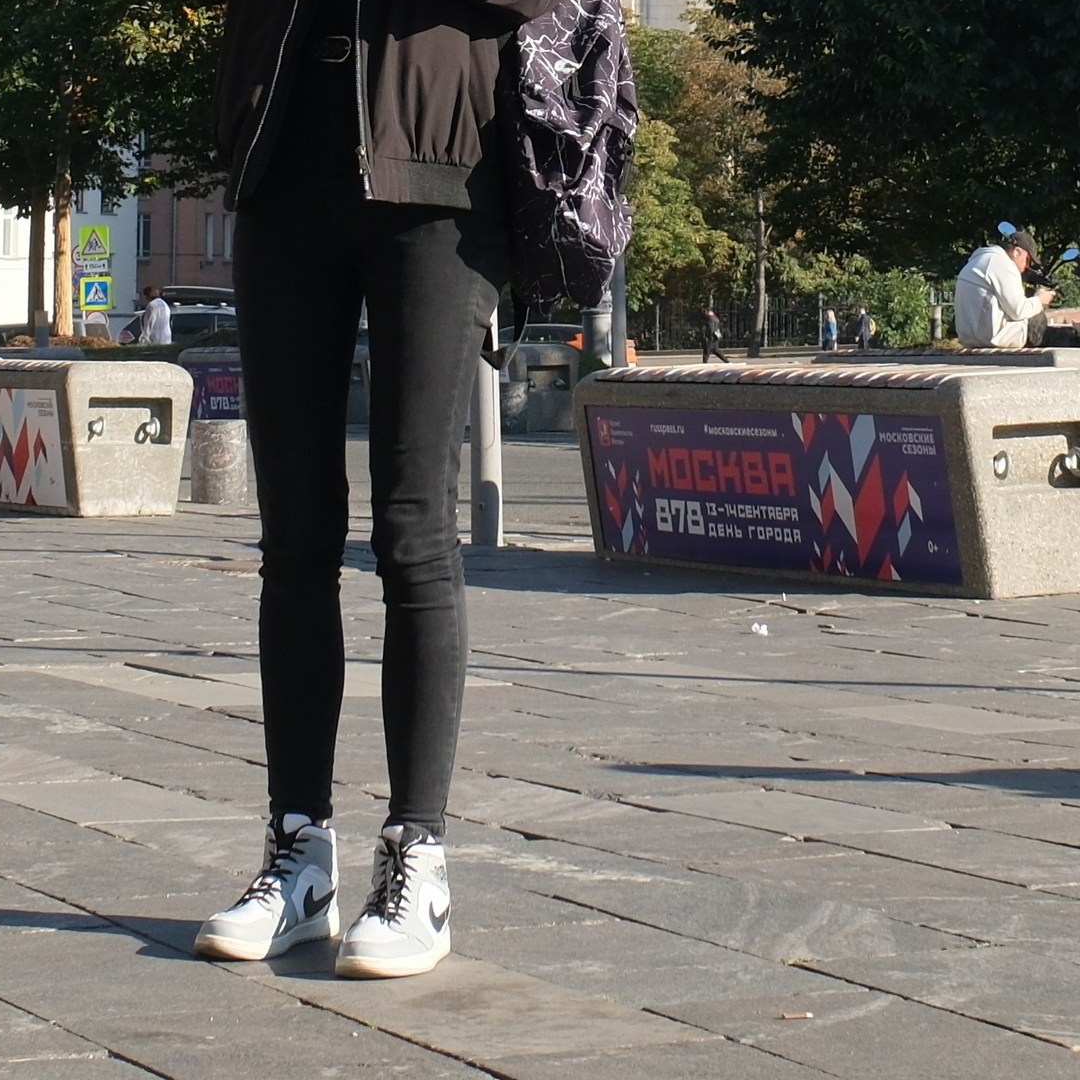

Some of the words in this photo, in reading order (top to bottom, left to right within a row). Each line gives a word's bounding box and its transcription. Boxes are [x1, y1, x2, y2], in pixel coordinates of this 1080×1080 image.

[650, 423, 685, 436] russpass.ru
[878, 431, 935, 444] МОСКОВСКИЕ
[901, 443, 937, 456] СЕЗОНЫ
[647, 446, 796, 497] МОСКВА
[655, 498, 706, 536] 878
[708, 523, 743, 539] ДЕНЬ
[748, 525, 802, 544] ГОРОДА
